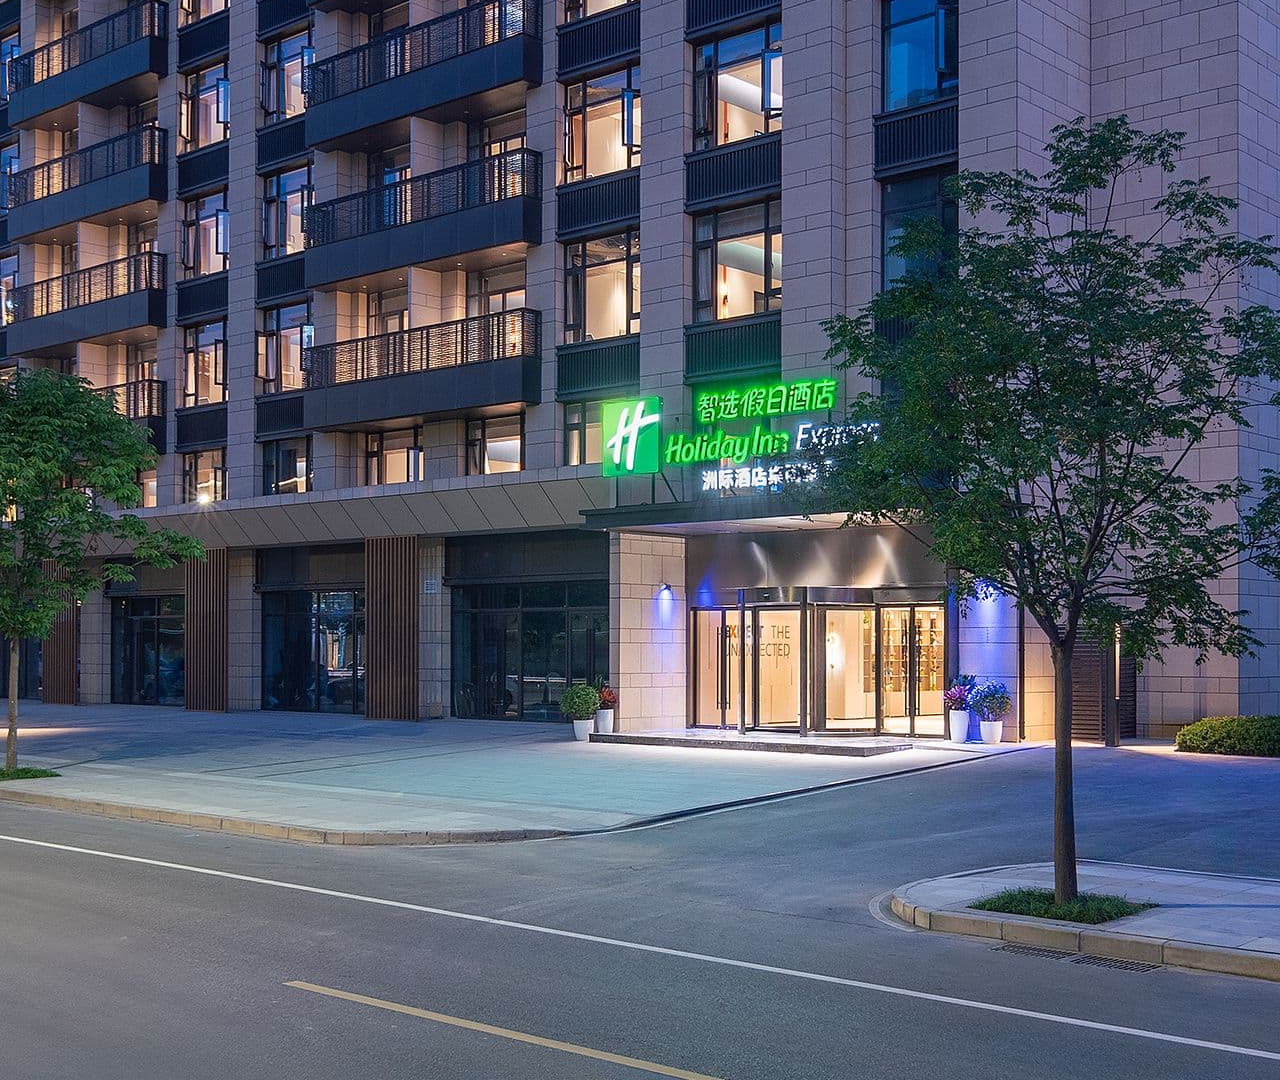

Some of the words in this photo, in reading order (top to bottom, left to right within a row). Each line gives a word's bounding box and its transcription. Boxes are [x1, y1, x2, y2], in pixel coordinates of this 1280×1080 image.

[697, 378, 837, 423] 智选假日酒店
[664, 428, 751, 464] Holiday
[752, 425, 789, 456] Inn
[770, 625, 790, 639] THE
